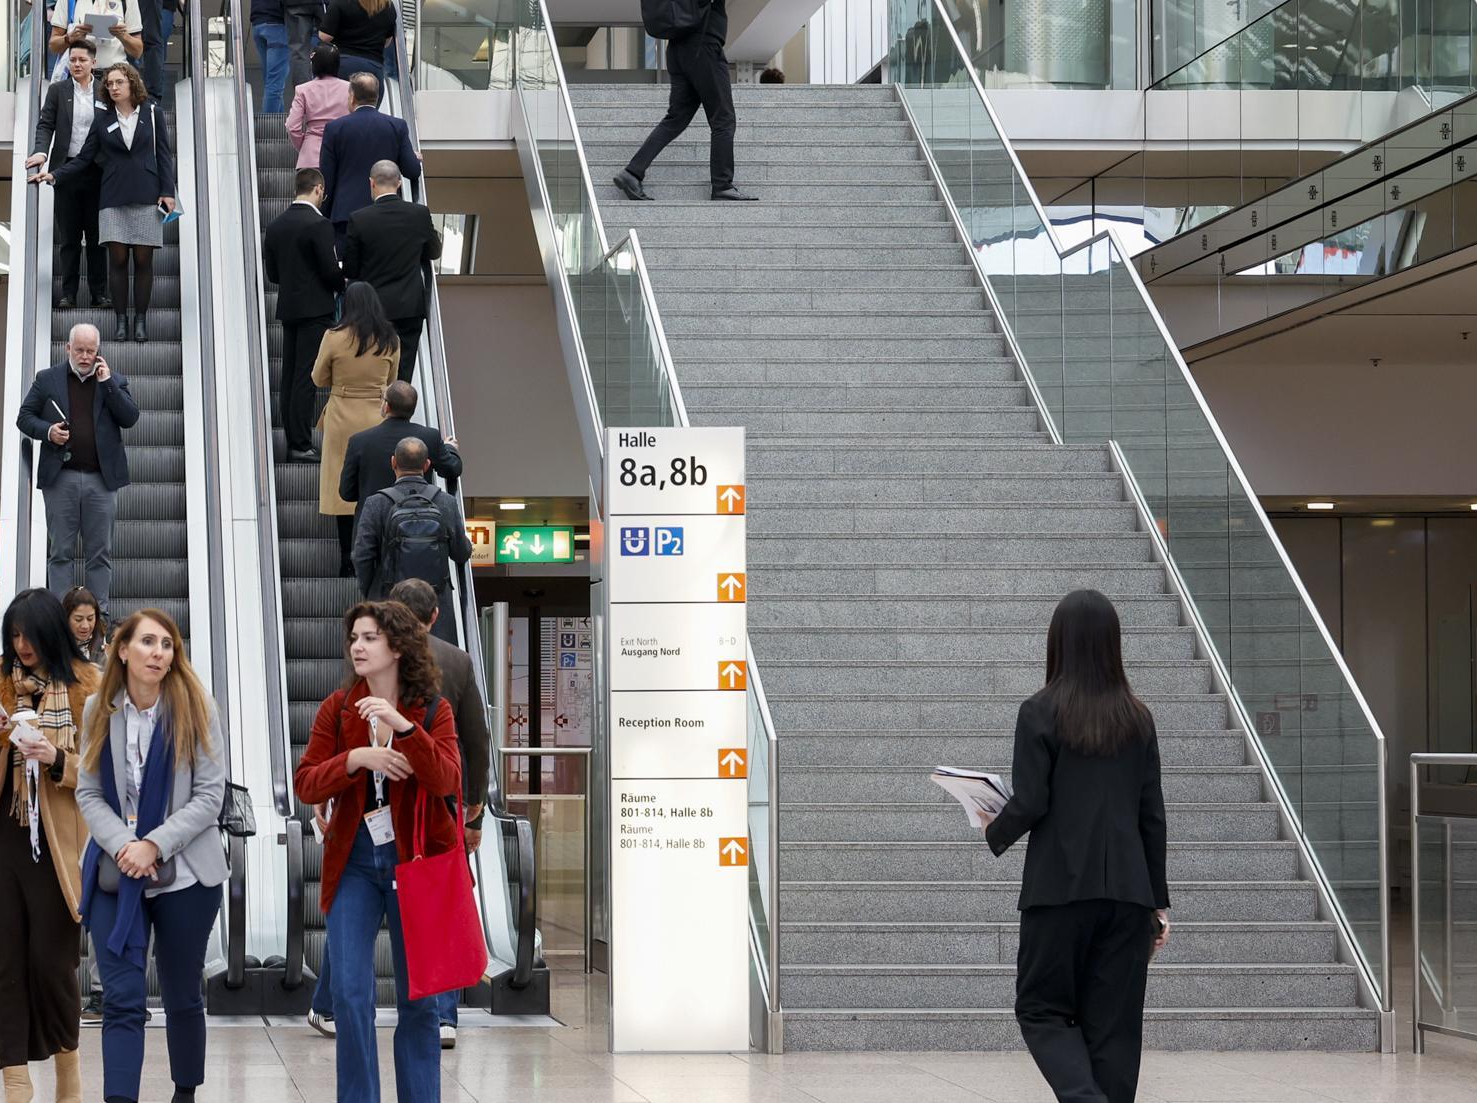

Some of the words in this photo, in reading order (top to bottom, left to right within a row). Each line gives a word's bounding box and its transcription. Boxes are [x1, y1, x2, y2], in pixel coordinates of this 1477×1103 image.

[618, 432, 656, 448] Halle
[619, 456, 708, 490] 8a,8b
[620, 637, 634, 646] Exit
[636, 637, 658, 646] North
[621, 648, 658, 658] Ausgang
[660, 647, 681, 656] Nord
[618, 717, 671, 729] Reception
[674, 717, 705, 728] Room
[620, 793, 657, 803] Räume
[620, 807, 667, 818] 801-814,
[670, 807, 697, 818] Halle
[700, 807, 714, 818] 8b
[620, 824, 654, 834] Räume
[620, 838, 663, 849] 801-814,
[666, 838, 691, 849] Halle
[693, 838, 706, 849] 8b
